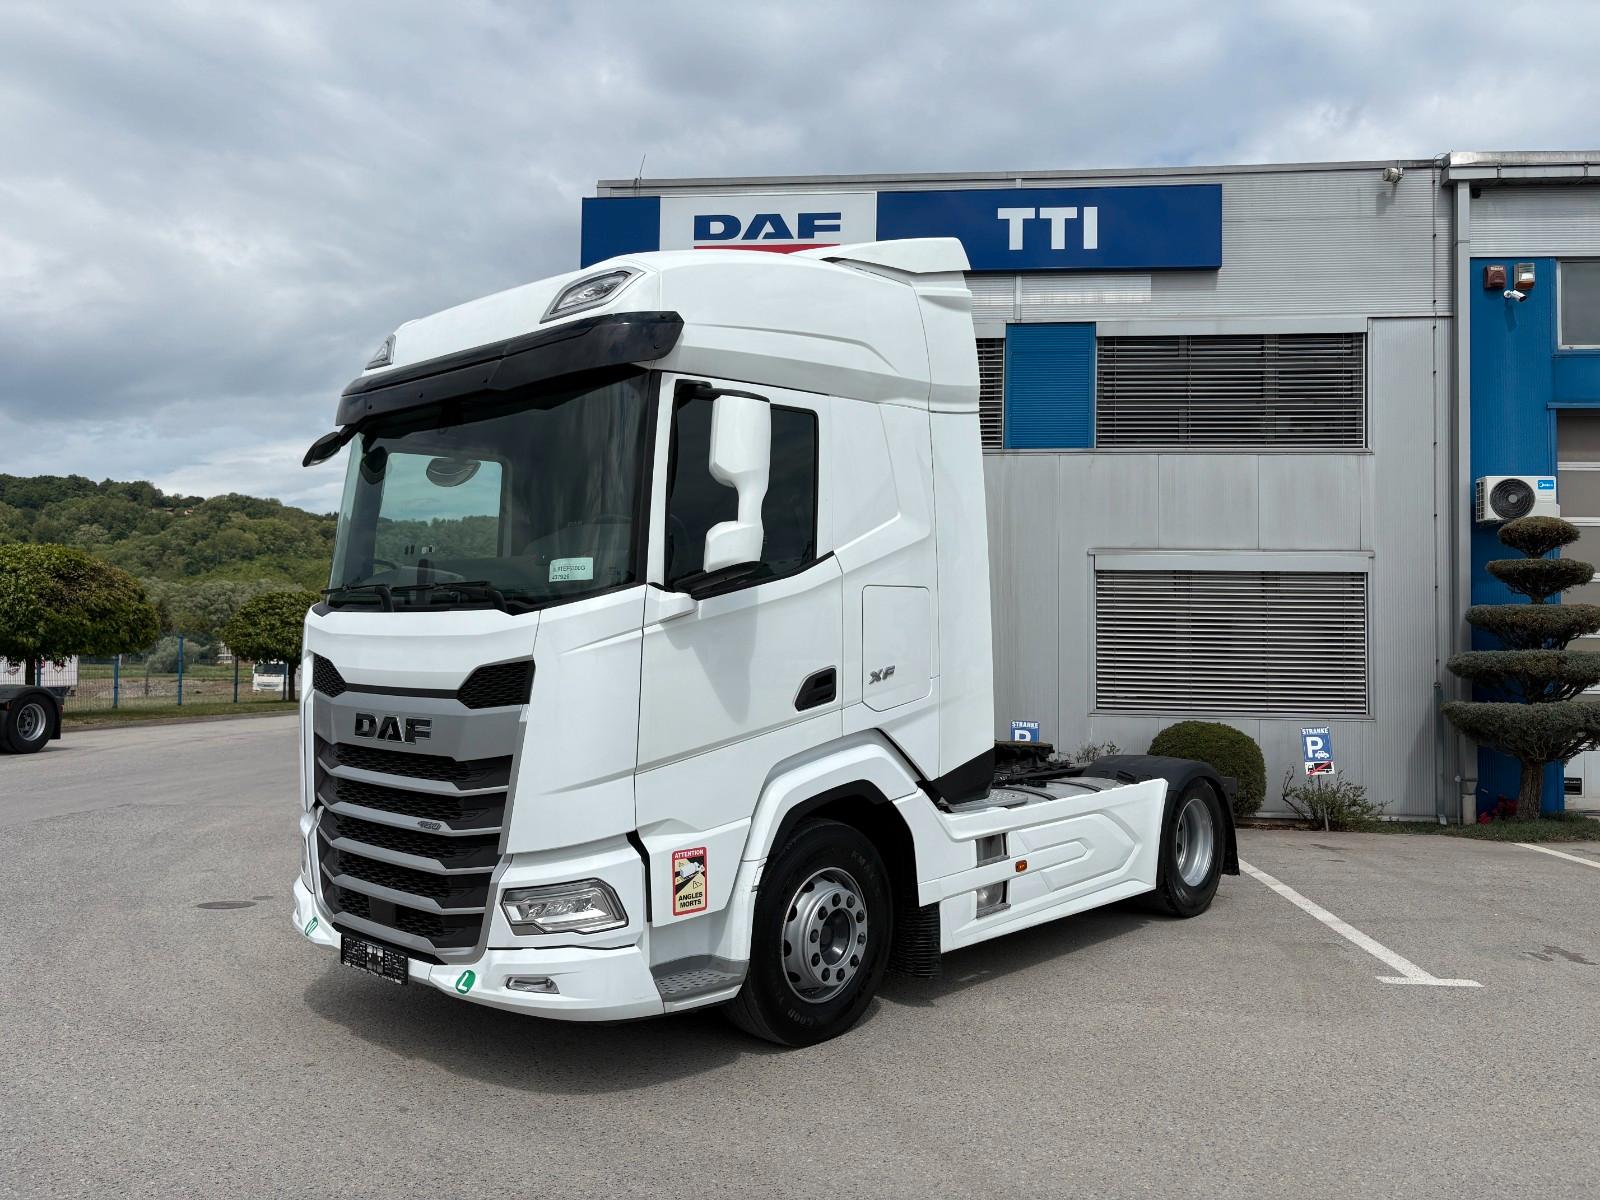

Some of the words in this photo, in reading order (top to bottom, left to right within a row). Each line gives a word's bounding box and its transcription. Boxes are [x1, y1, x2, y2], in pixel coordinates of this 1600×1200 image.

[693, 212, 842, 241] DAF
[997, 206, 1098, 251] TTI
[869, 665, 896, 685] XF
[354, 712, 432, 745] DAF
[1306, 736, 1323, 758] P
[674, 849, 704, 859] ATTENTION
[678, 892, 703, 901] ANGLES
[679, 899, 702, 909] MORTS
[457, 972, 468, 991] L
